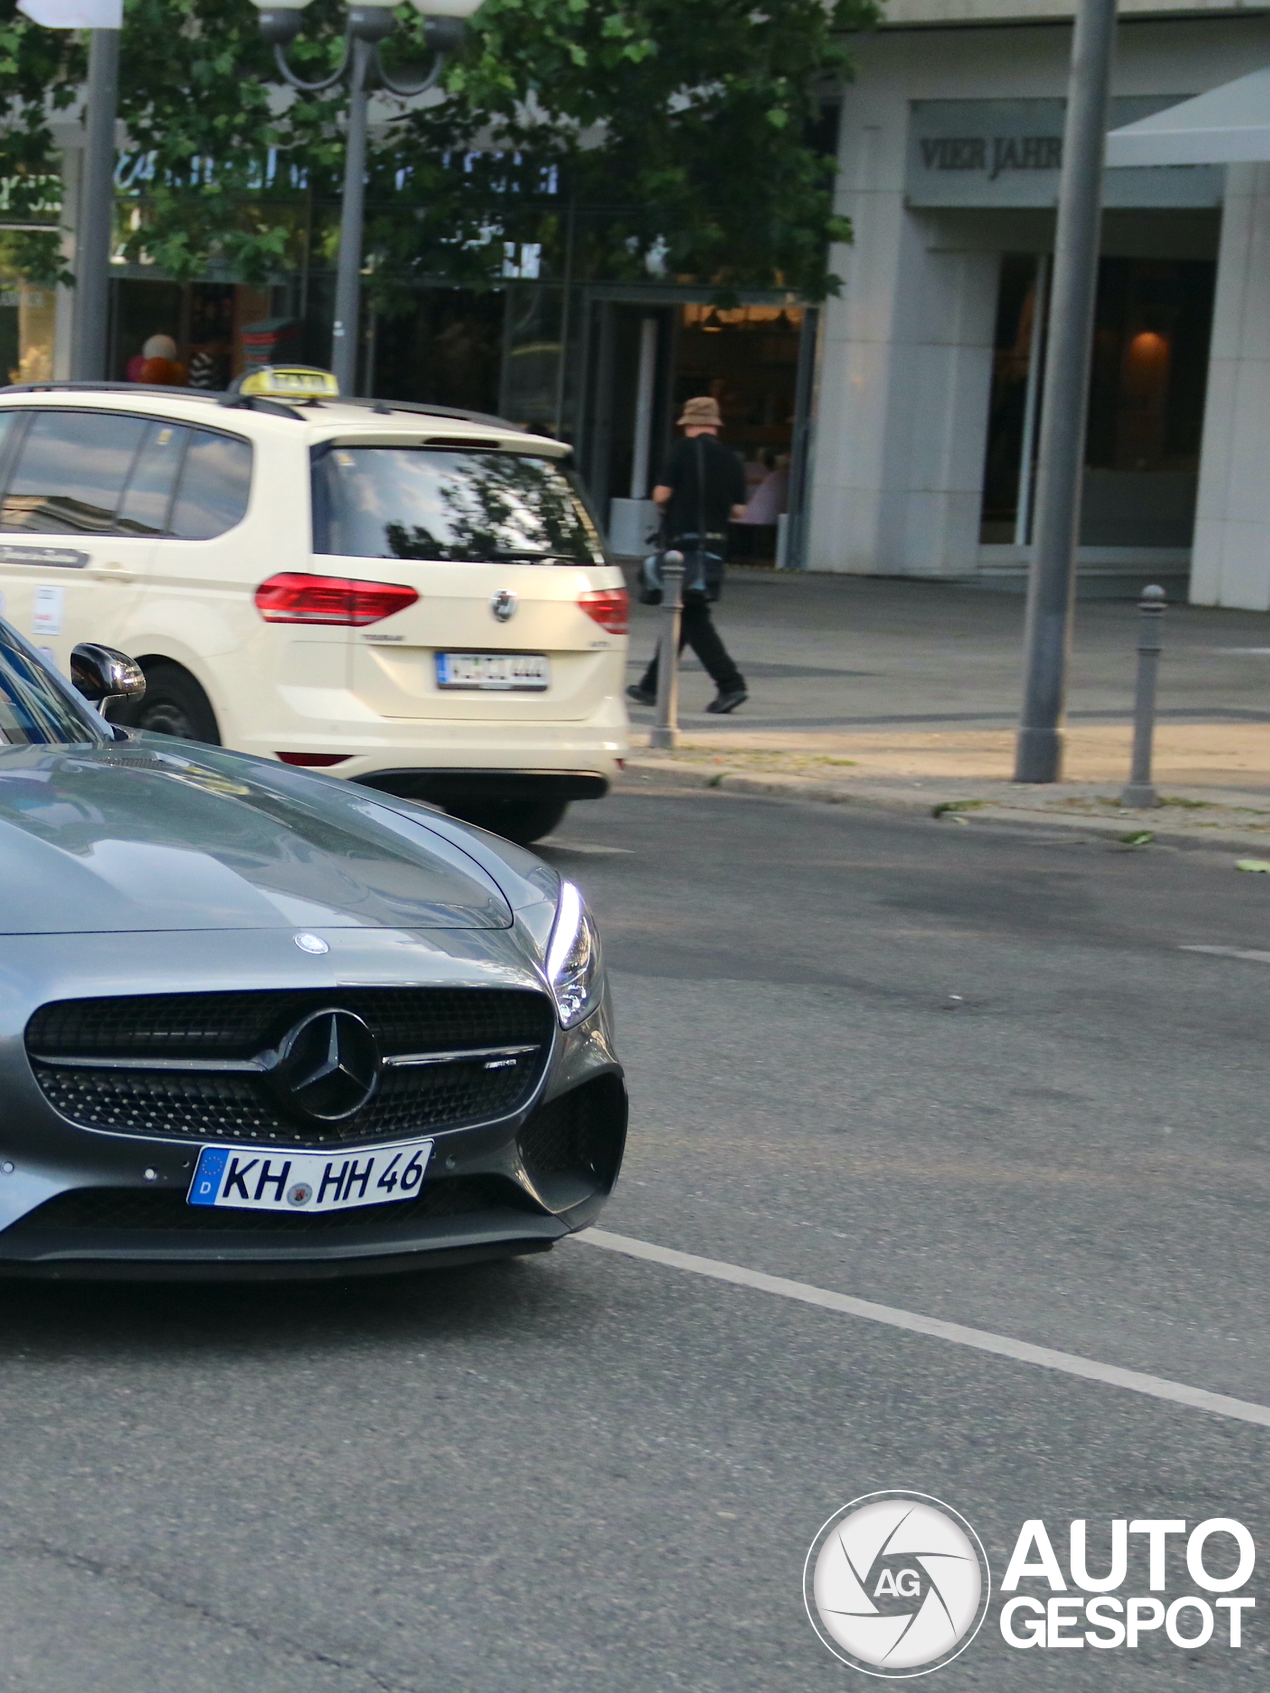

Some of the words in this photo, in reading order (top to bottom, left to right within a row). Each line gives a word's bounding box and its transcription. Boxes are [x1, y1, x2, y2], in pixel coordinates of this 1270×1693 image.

[920, 136, 986, 170] VIER
[199, 1182, 212, 1195] D
[222, 1157, 292, 1202] KH
[316, 1157, 375, 1204] HH
[377, 1150, 424, 1194] 46
